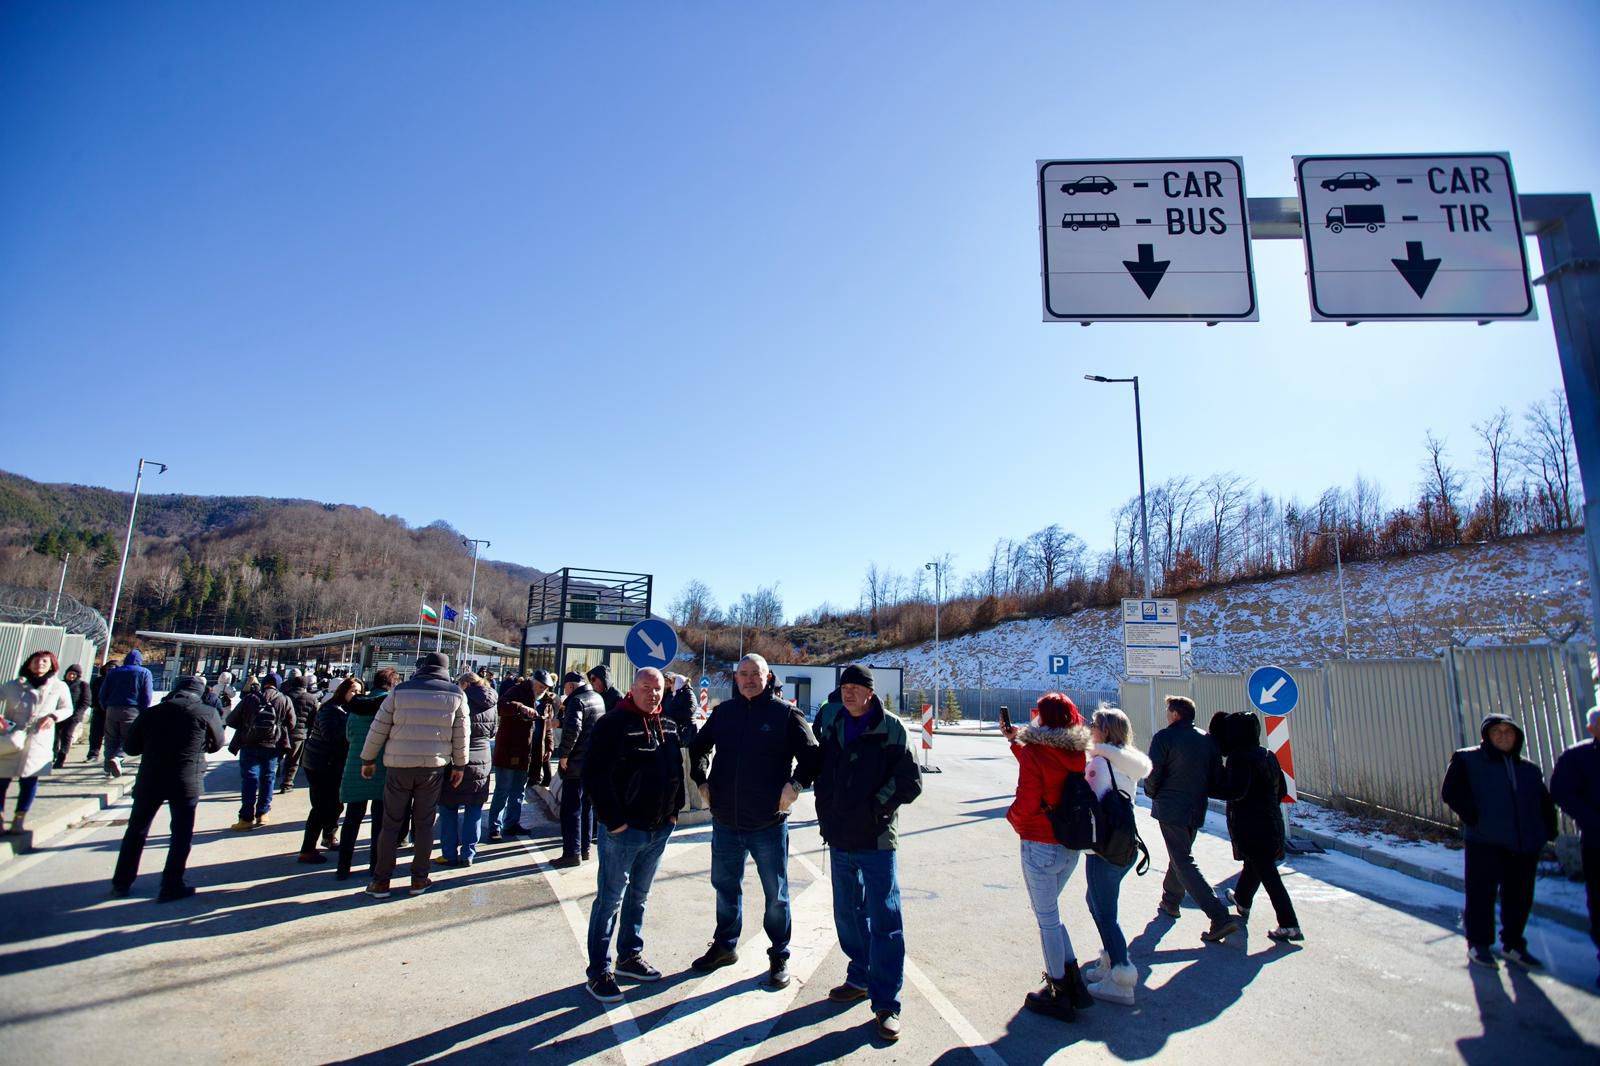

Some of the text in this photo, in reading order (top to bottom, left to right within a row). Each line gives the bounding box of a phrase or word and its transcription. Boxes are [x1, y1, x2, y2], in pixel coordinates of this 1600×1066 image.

[1163, 171, 1223, 198] CAR
[1427, 166, 1492, 194] CAR
[1166, 207, 1227, 235] BUS
[1440, 204, 1492, 232] TIR
[1053, 657, 1064, 673] P
